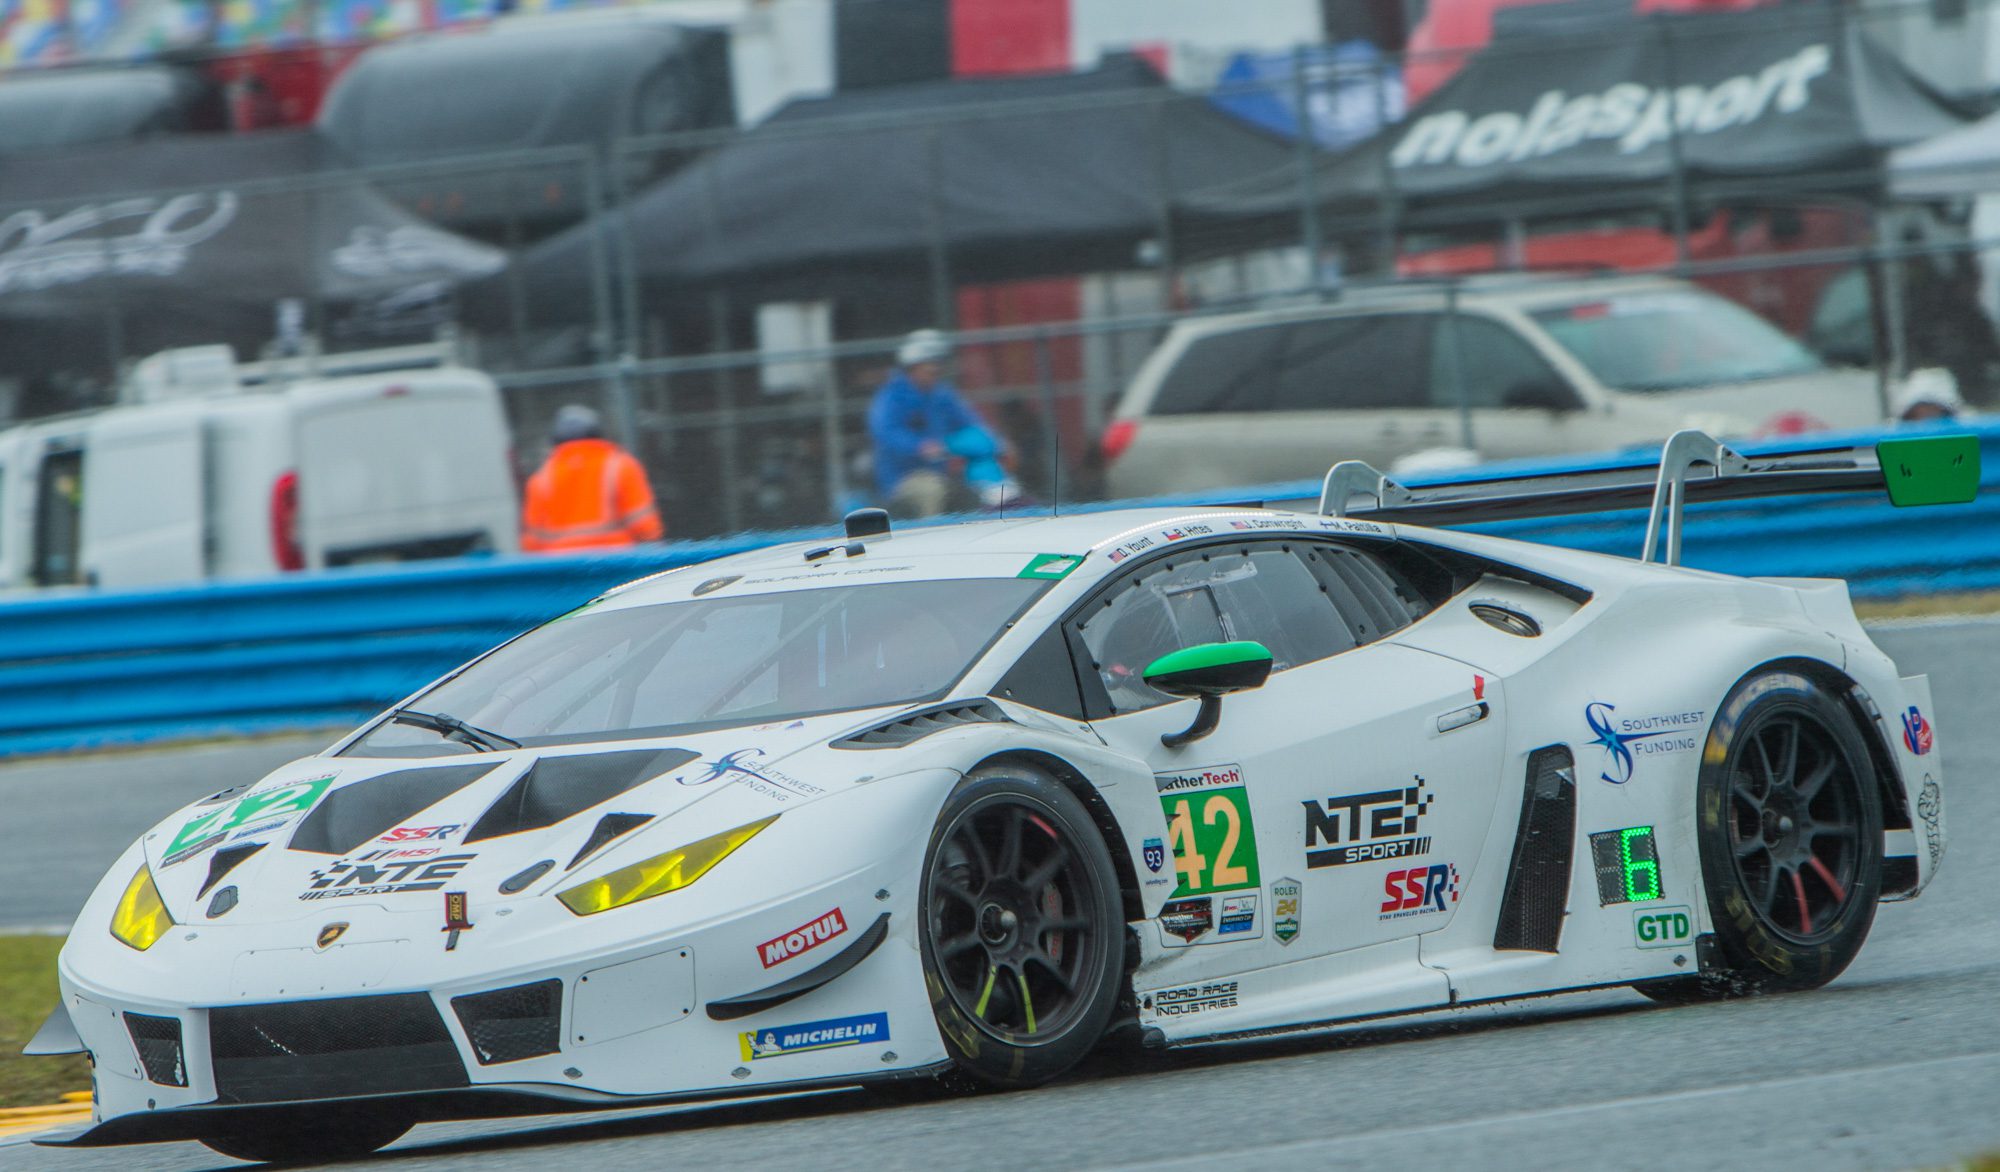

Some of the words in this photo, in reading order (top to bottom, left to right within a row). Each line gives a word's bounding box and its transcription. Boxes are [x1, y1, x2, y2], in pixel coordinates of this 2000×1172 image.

[1389, 43, 1832, 169] nolasport
[1125, 536, 1154, 553] Yount
[180, 783, 314, 846] 42
[1301, 788, 1404, 848] NTE
[379, 824, 461, 842] SSR
[1168, 795, 1249, 890] 42
[1147, 850, 1162, 868] 93
[1345, 840, 1410, 863] SPORT
[1621, 826, 1659, 902] 6
[334, 853, 479, 888] NTE
[321, 884, 407, 898] SPORT
[1274, 886, 1298, 897] ROLEX
[1380, 864, 1449, 912] SSR
[1275, 899, 1297, 916] 24
[765, 913, 843, 965] MOTUL
[1637, 913, 1690, 942] GTD
[1157, 988, 1198, 1002] ROAD
[1202, 981, 1238, 996] RACE
[1155, 997, 1239, 1017] INDUSTRIES
[783, 1022, 877, 1047] MICHELIN
